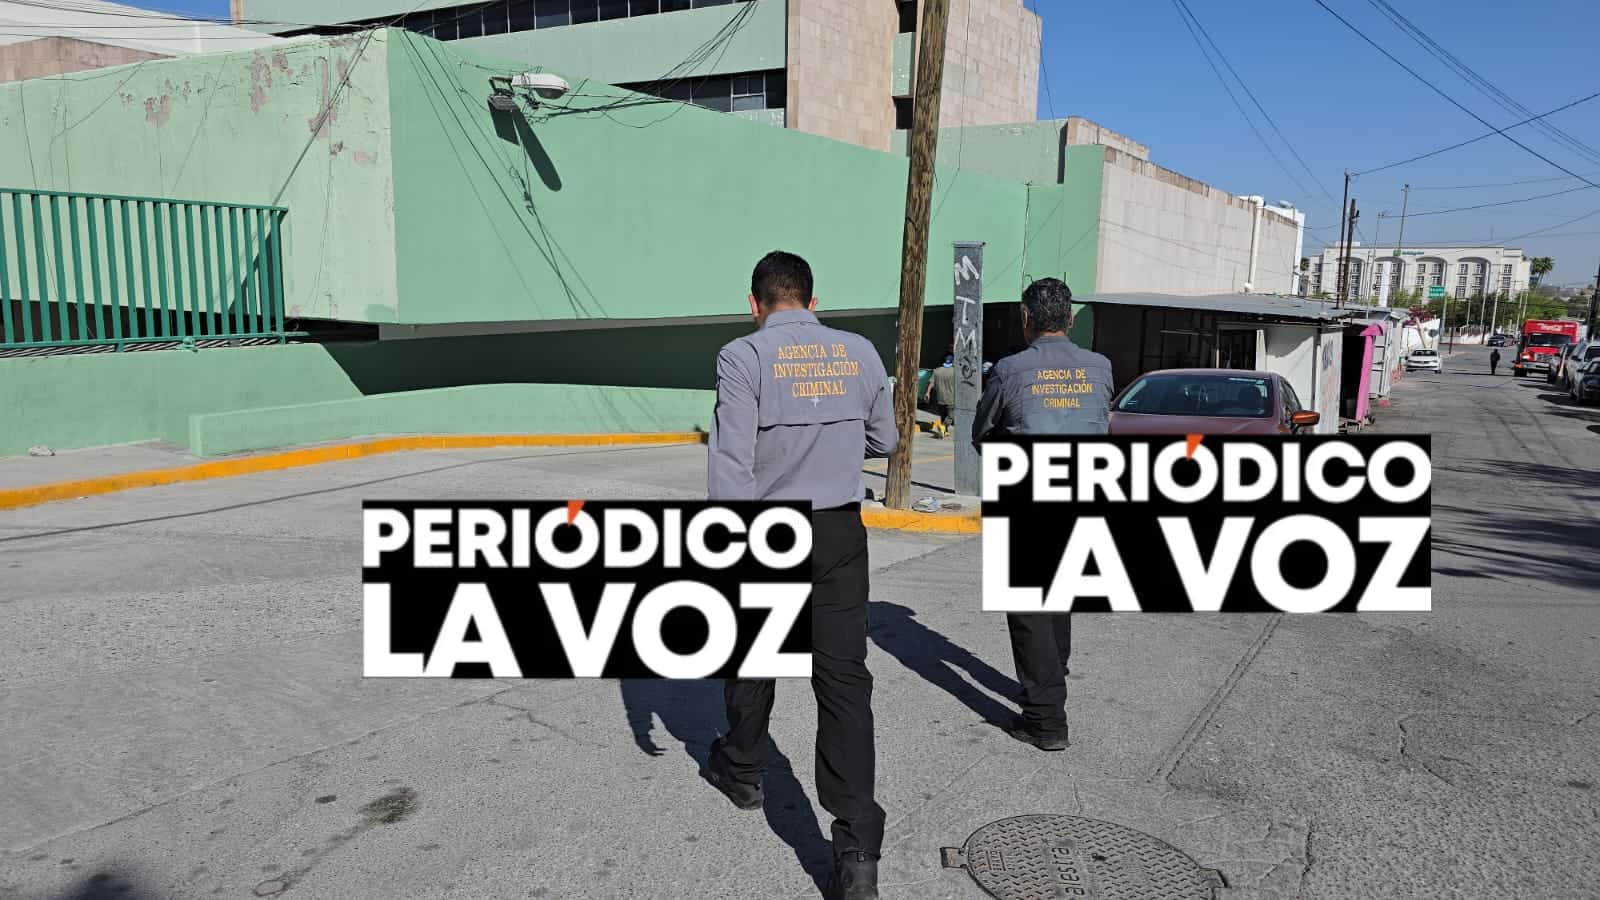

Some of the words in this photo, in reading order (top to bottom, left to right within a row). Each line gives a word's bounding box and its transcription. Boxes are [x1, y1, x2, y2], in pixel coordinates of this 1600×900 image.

[777, 344, 828, 360] AGENCIA
[831, 343, 848, 358] DE
[1037, 369, 1072, 381] AGENCIA
[1075, 368, 1087, 379] DE
[791, 380, 847, 398] CRIMINAL
[1031, 380, 1093, 395] INVESTIGACIÓN
[1043, 397, 1081, 408] CRIMINAL
[1051, 847, 1085, 896] alestra
